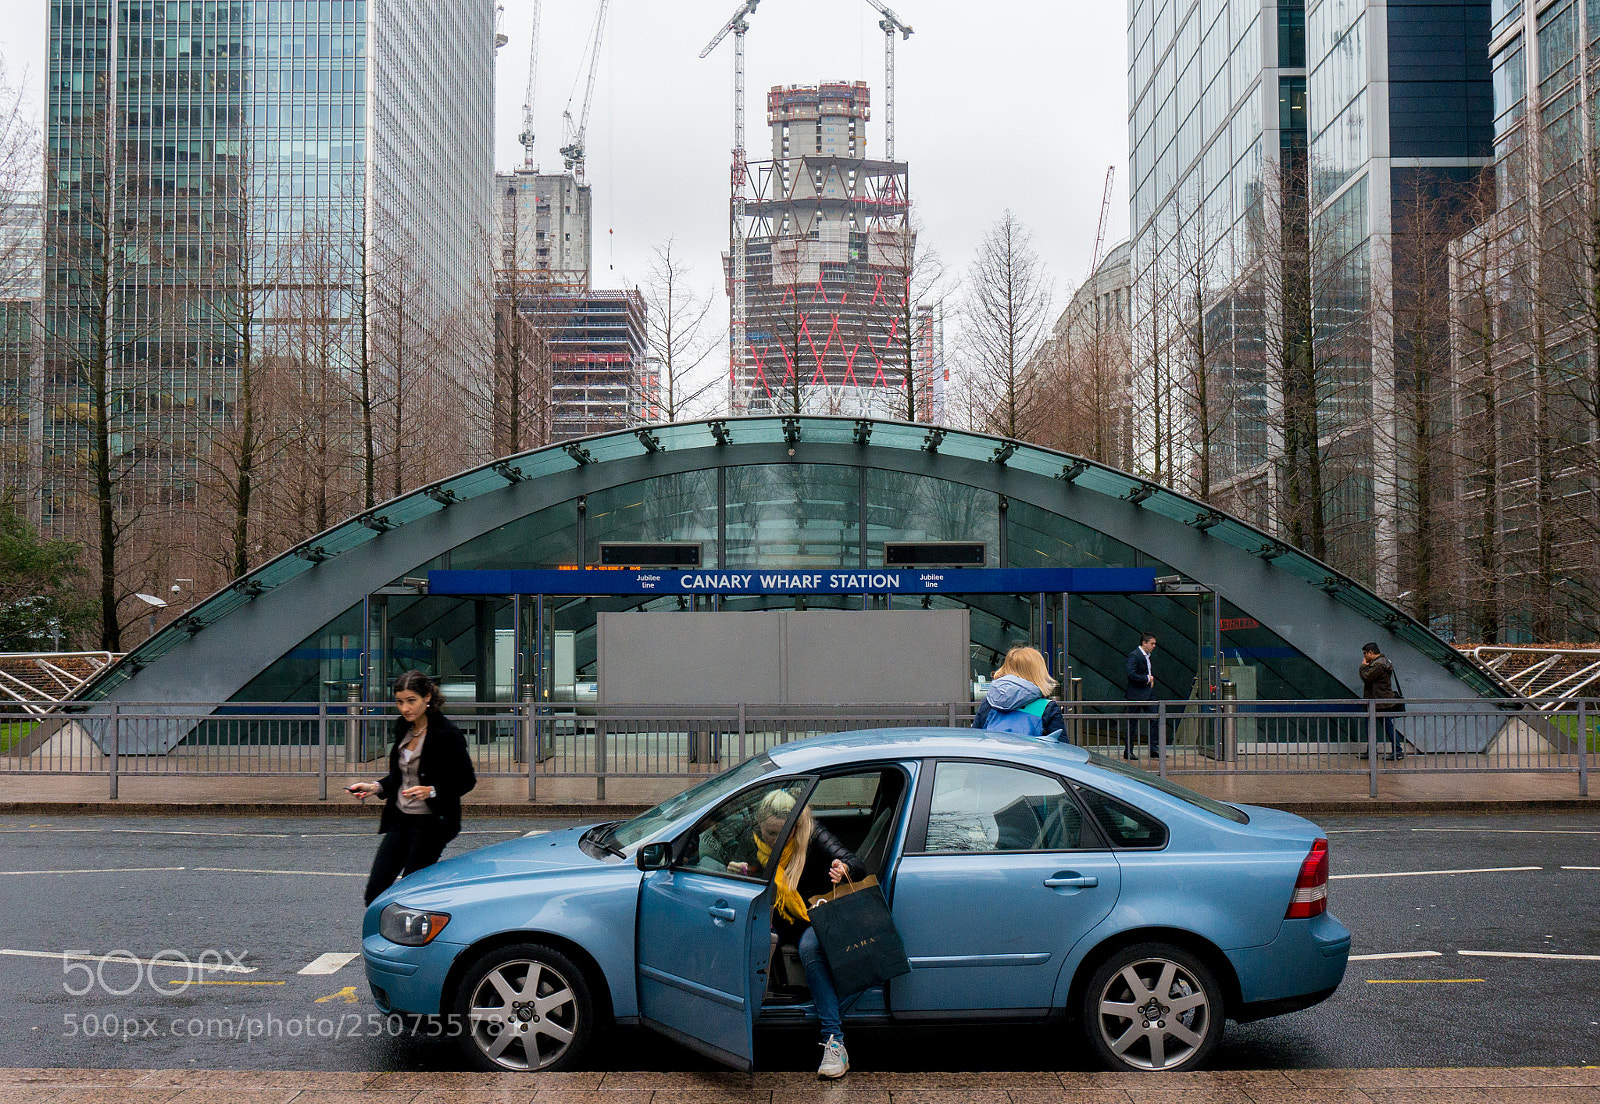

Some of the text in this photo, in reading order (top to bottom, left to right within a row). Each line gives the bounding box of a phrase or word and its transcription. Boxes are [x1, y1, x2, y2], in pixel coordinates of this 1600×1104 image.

[636, 574, 661, 582] Jubilee
[680, 574, 900, 589] CANARY WHARF STATION
[919, 573, 944, 581] Jubilee
[845, 937, 875, 952] ZARA
